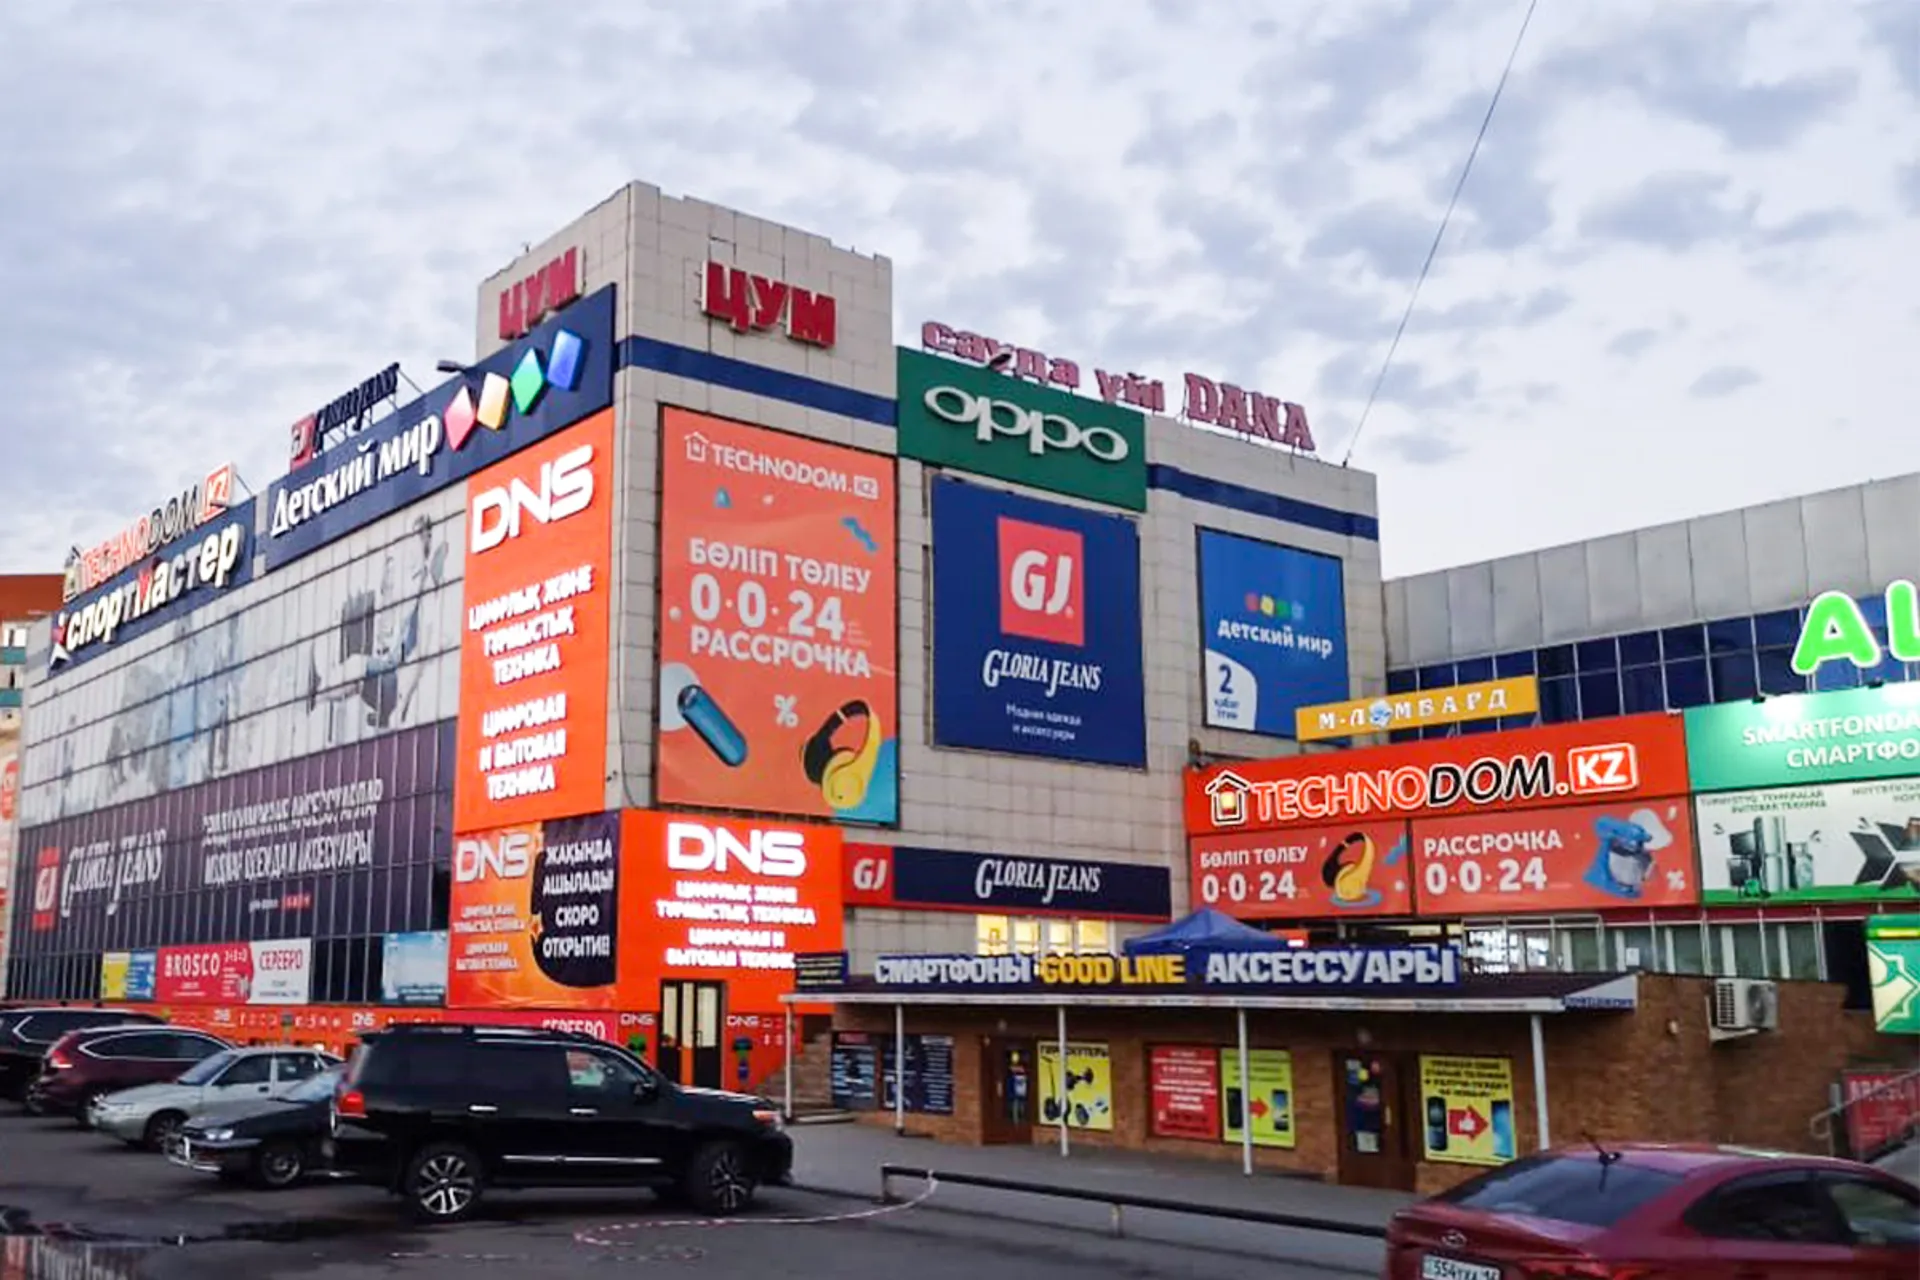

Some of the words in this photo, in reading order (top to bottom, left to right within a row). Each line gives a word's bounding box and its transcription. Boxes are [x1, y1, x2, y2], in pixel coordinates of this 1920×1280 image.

[500, 246, 583, 339] ЦУМ
[703, 261, 836, 348] ЦУМ
[1185, 373, 1315, 452] DANA
[271, 440, 376, 538] Детский
[378, 414, 441, 480] мир
[470, 445, 594, 554] DNS
[784, 554, 872, 594] ТӨЛЕУ
[1010, 549, 1073, 616] GJ
[690, 625, 871, 678] РАССРОЧКА
[1218, 663, 1234, 694] 2
[455, 833, 530, 883] DNS
[666, 822, 807, 877] DNS
[1255, 845, 1309, 866] ТӨЛЕУ
[1423, 827, 1563, 857] РАССРОЧКА
[853, 858, 887, 891] GJ
[555, 904, 600, 928] СКОРО
[874, 955, 1032, 984] СМАРТФОНЫ
[1040, 953, 1116, 984] GOOD
[1119, 954, 1186, 984] LINE
[1205, 948, 1458, 985] АКСЕССУАРЫ
[726, 1015, 760, 1027] DNS
